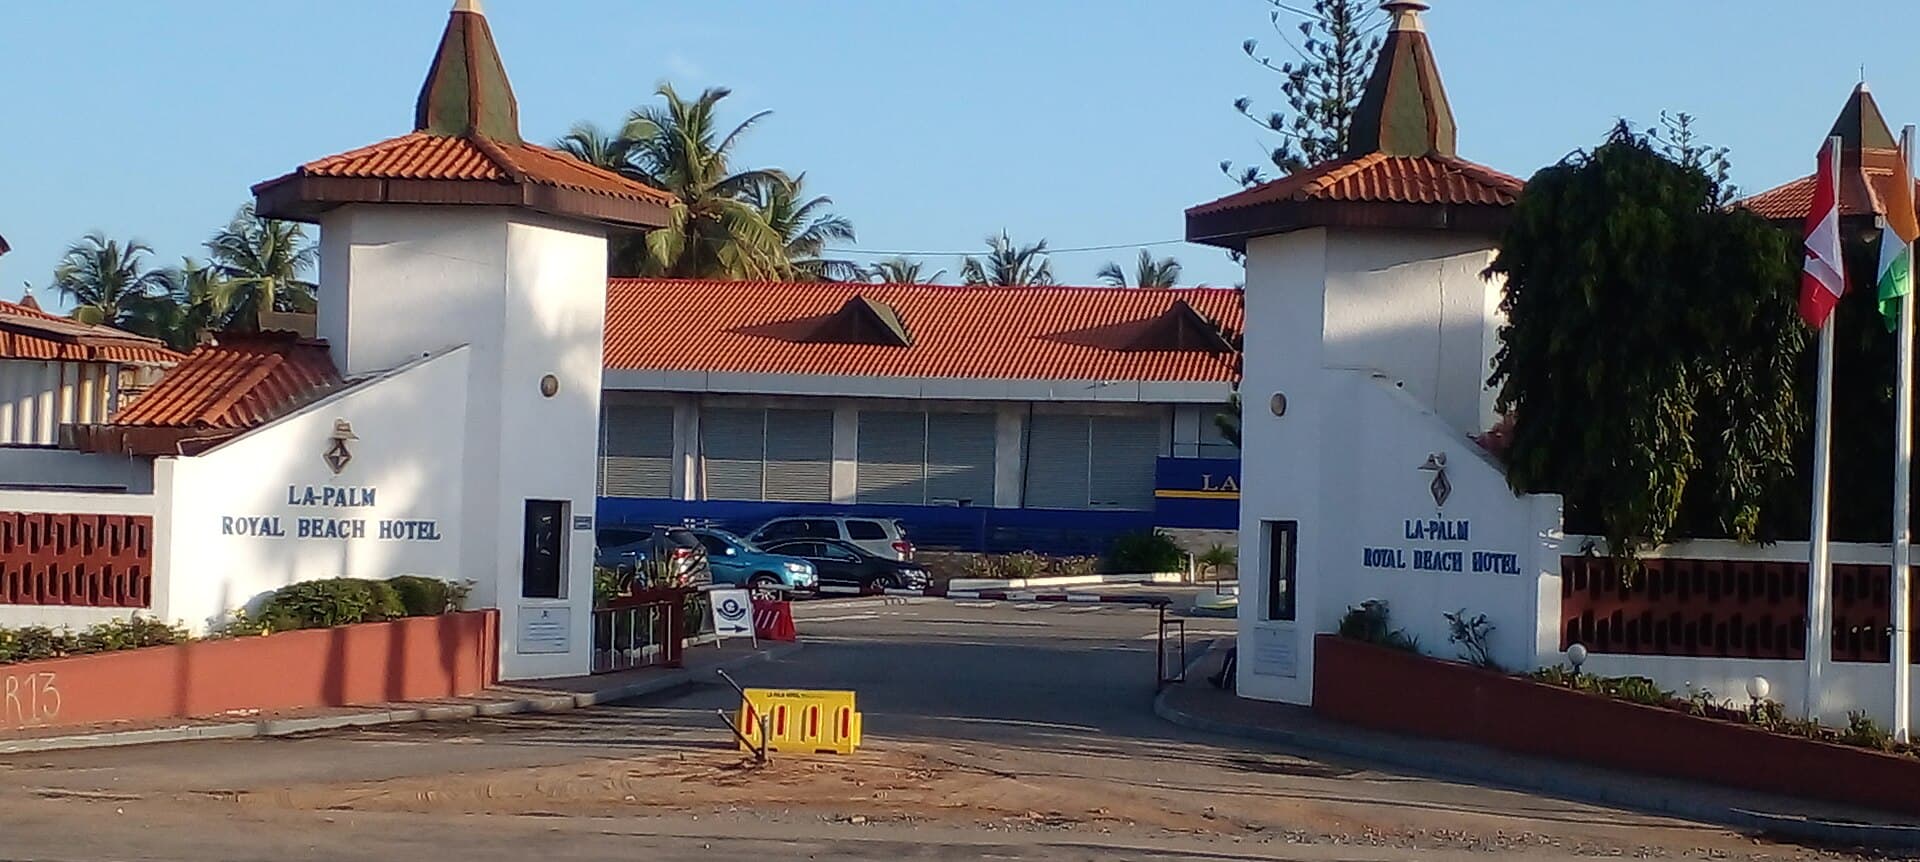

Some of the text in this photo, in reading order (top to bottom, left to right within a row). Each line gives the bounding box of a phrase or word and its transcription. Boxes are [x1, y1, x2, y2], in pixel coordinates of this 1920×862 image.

[288, 485, 376, 507] LA-PALM
[222, 516, 441, 540] ROYAL BEACH HOTEL
[1405, 519, 1469, 541] LA-PALM
[1363, 547, 1521, 575] ROYAL BEACH HOTEL
[6, 672, 61, 721] R13
